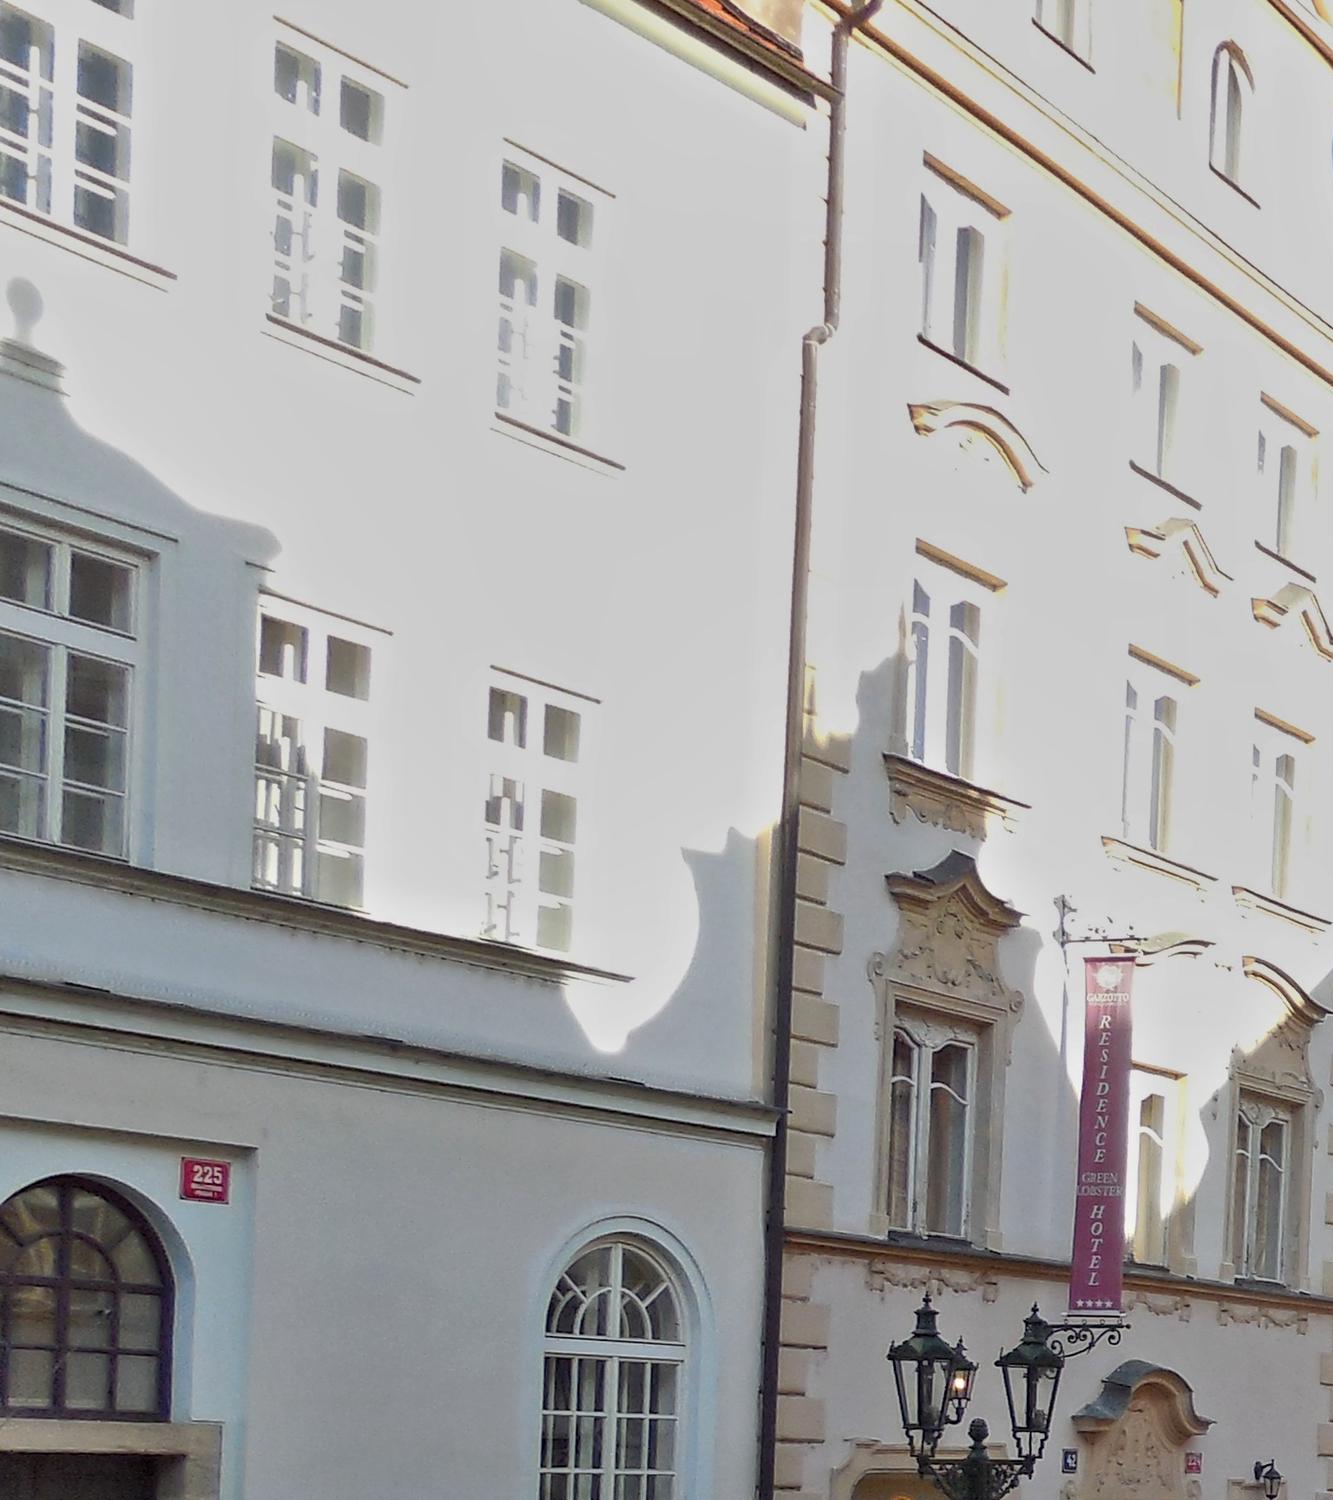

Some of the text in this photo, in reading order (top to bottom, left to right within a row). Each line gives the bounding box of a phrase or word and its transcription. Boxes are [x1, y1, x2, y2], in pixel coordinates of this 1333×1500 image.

[1094, 1015, 1112, 1163] RESIDENCE
[193, 1164, 223, 1185] 225
[1081, 1172, 1119, 1183] GREEN
[1088, 1204, 1105, 1286] HOTEL
